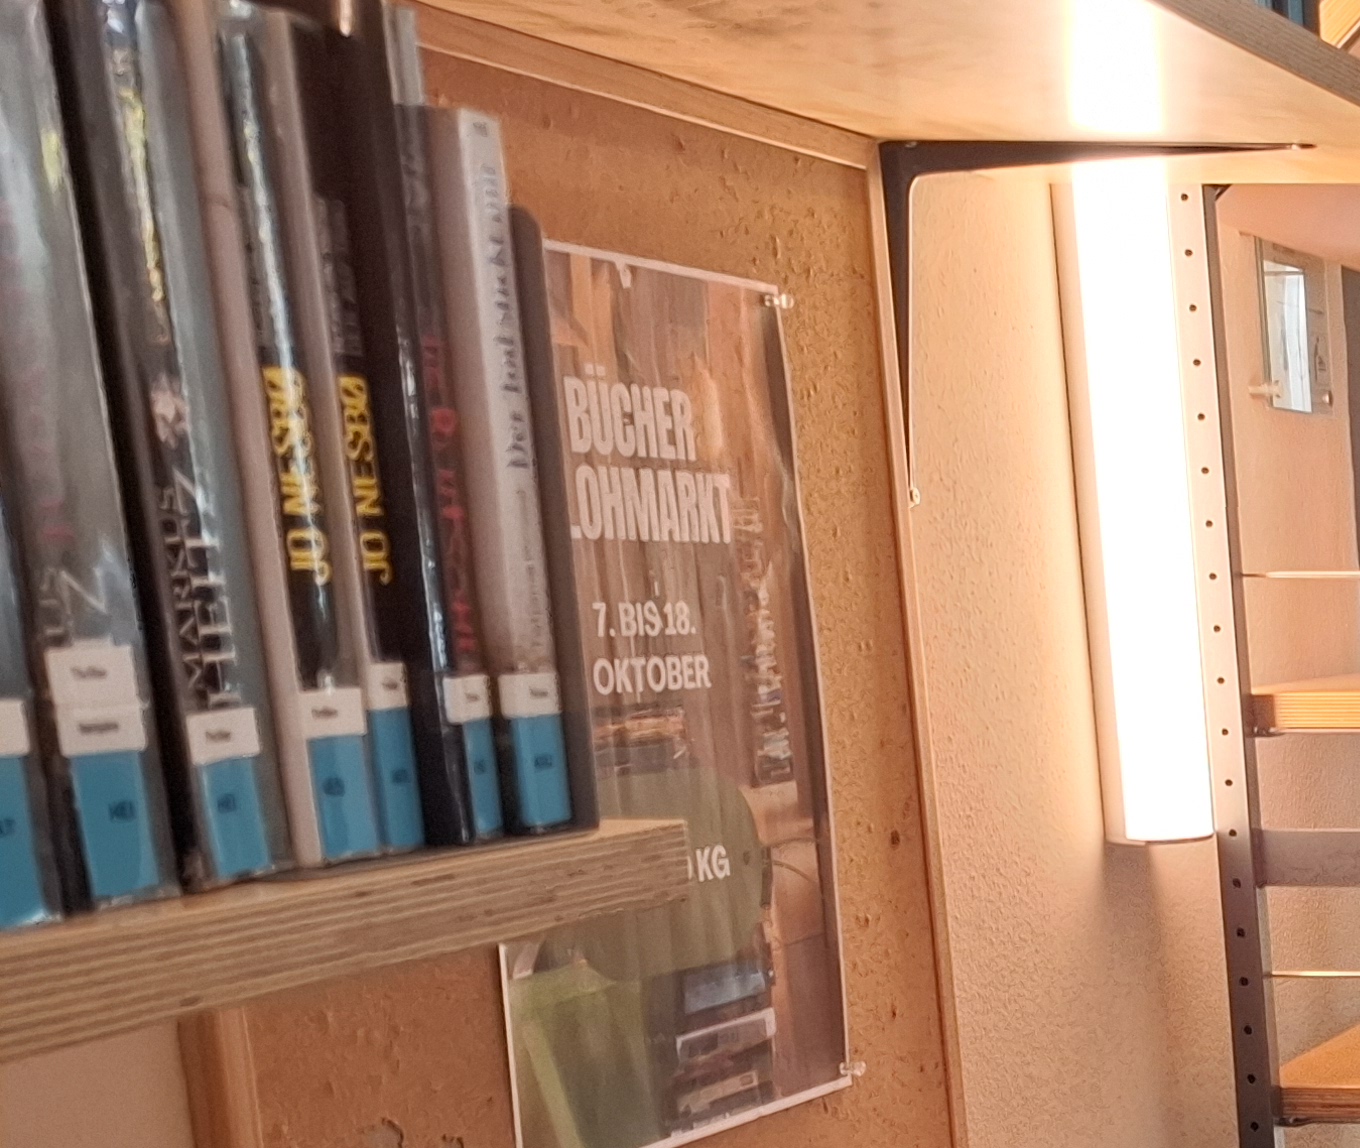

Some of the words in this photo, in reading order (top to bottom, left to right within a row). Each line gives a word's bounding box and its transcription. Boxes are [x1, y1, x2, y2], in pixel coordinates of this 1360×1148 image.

[563, 362, 697, 462] BÜCHER
[338, 374, 386, 518] NESBØ
[571, 463, 732, 545] OHMARKT
[286, 528, 332, 586] JO
[358, 531, 393, 586] JO
[592, 601, 616, 638] 7.
[619, 600, 663, 638] BIS
[663, 600, 697, 637] 18.
[593, 652, 713, 696] OKTOBER
[694, 845, 732, 883] KG
